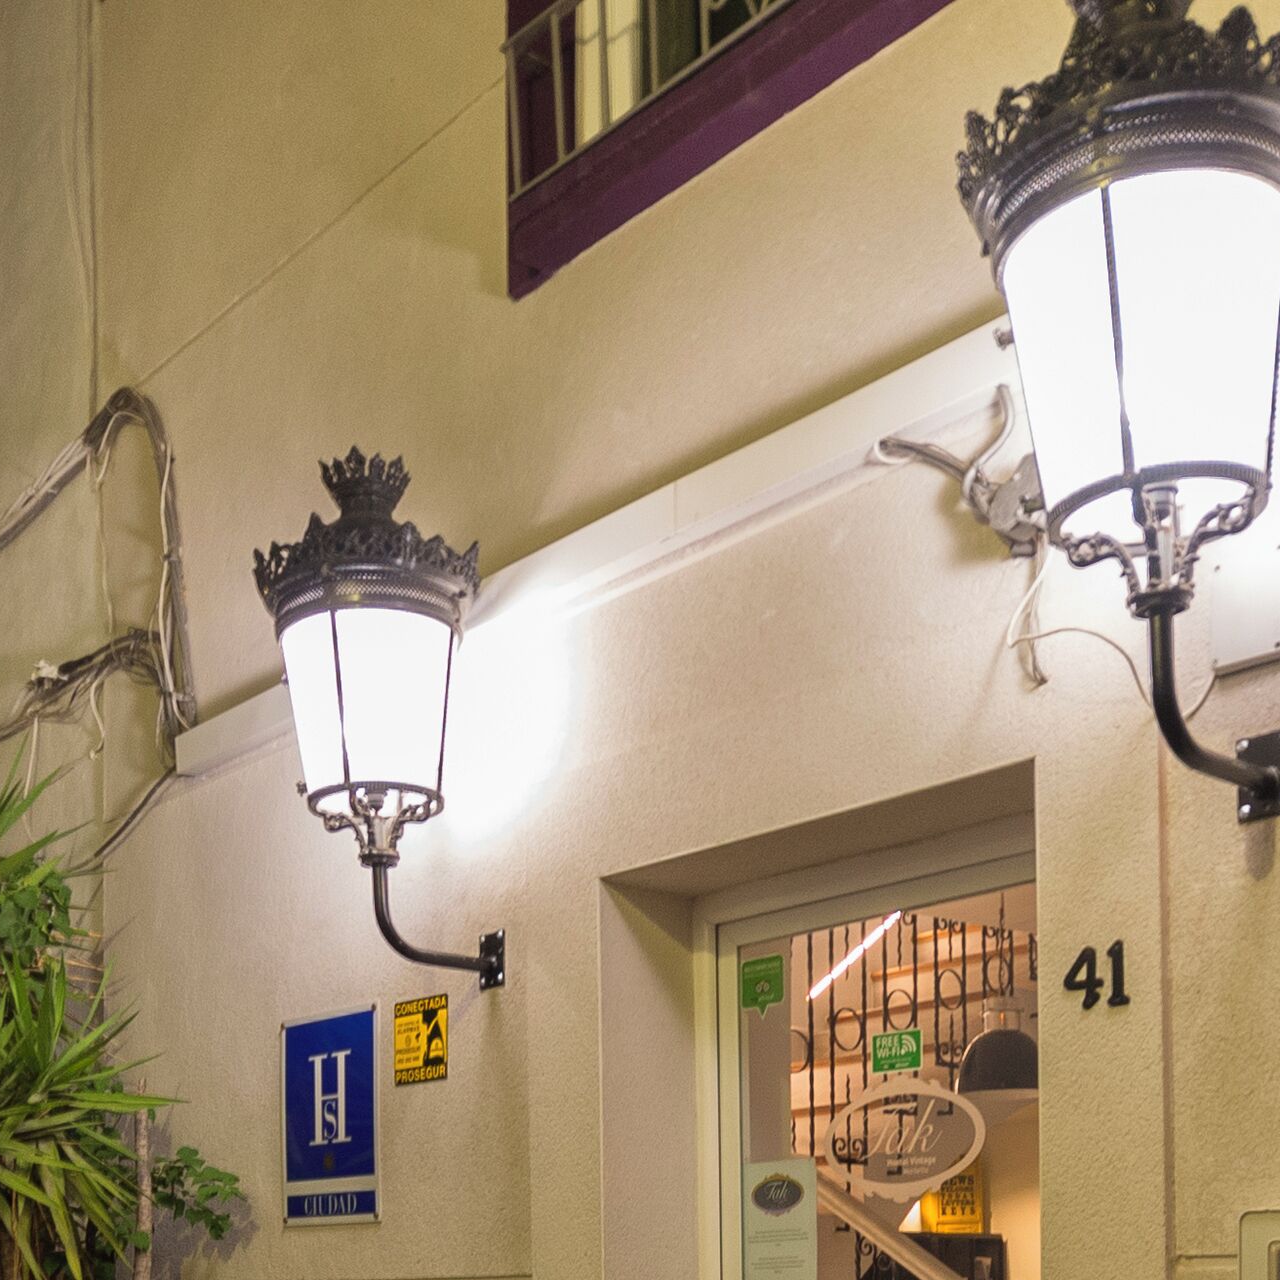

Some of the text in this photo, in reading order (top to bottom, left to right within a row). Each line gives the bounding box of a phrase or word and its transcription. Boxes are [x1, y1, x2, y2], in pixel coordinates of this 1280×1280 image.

[1063, 939, 1131, 1011] 41
[396, 995, 447, 1016] CONECTADA
[876, 1034, 900, 1049] FREE
[396, 1064, 447, 1084] PROSEGUR
[304, 1193, 357, 1216] CIUDAD
[941, 1206, 976, 1216] KEYS
